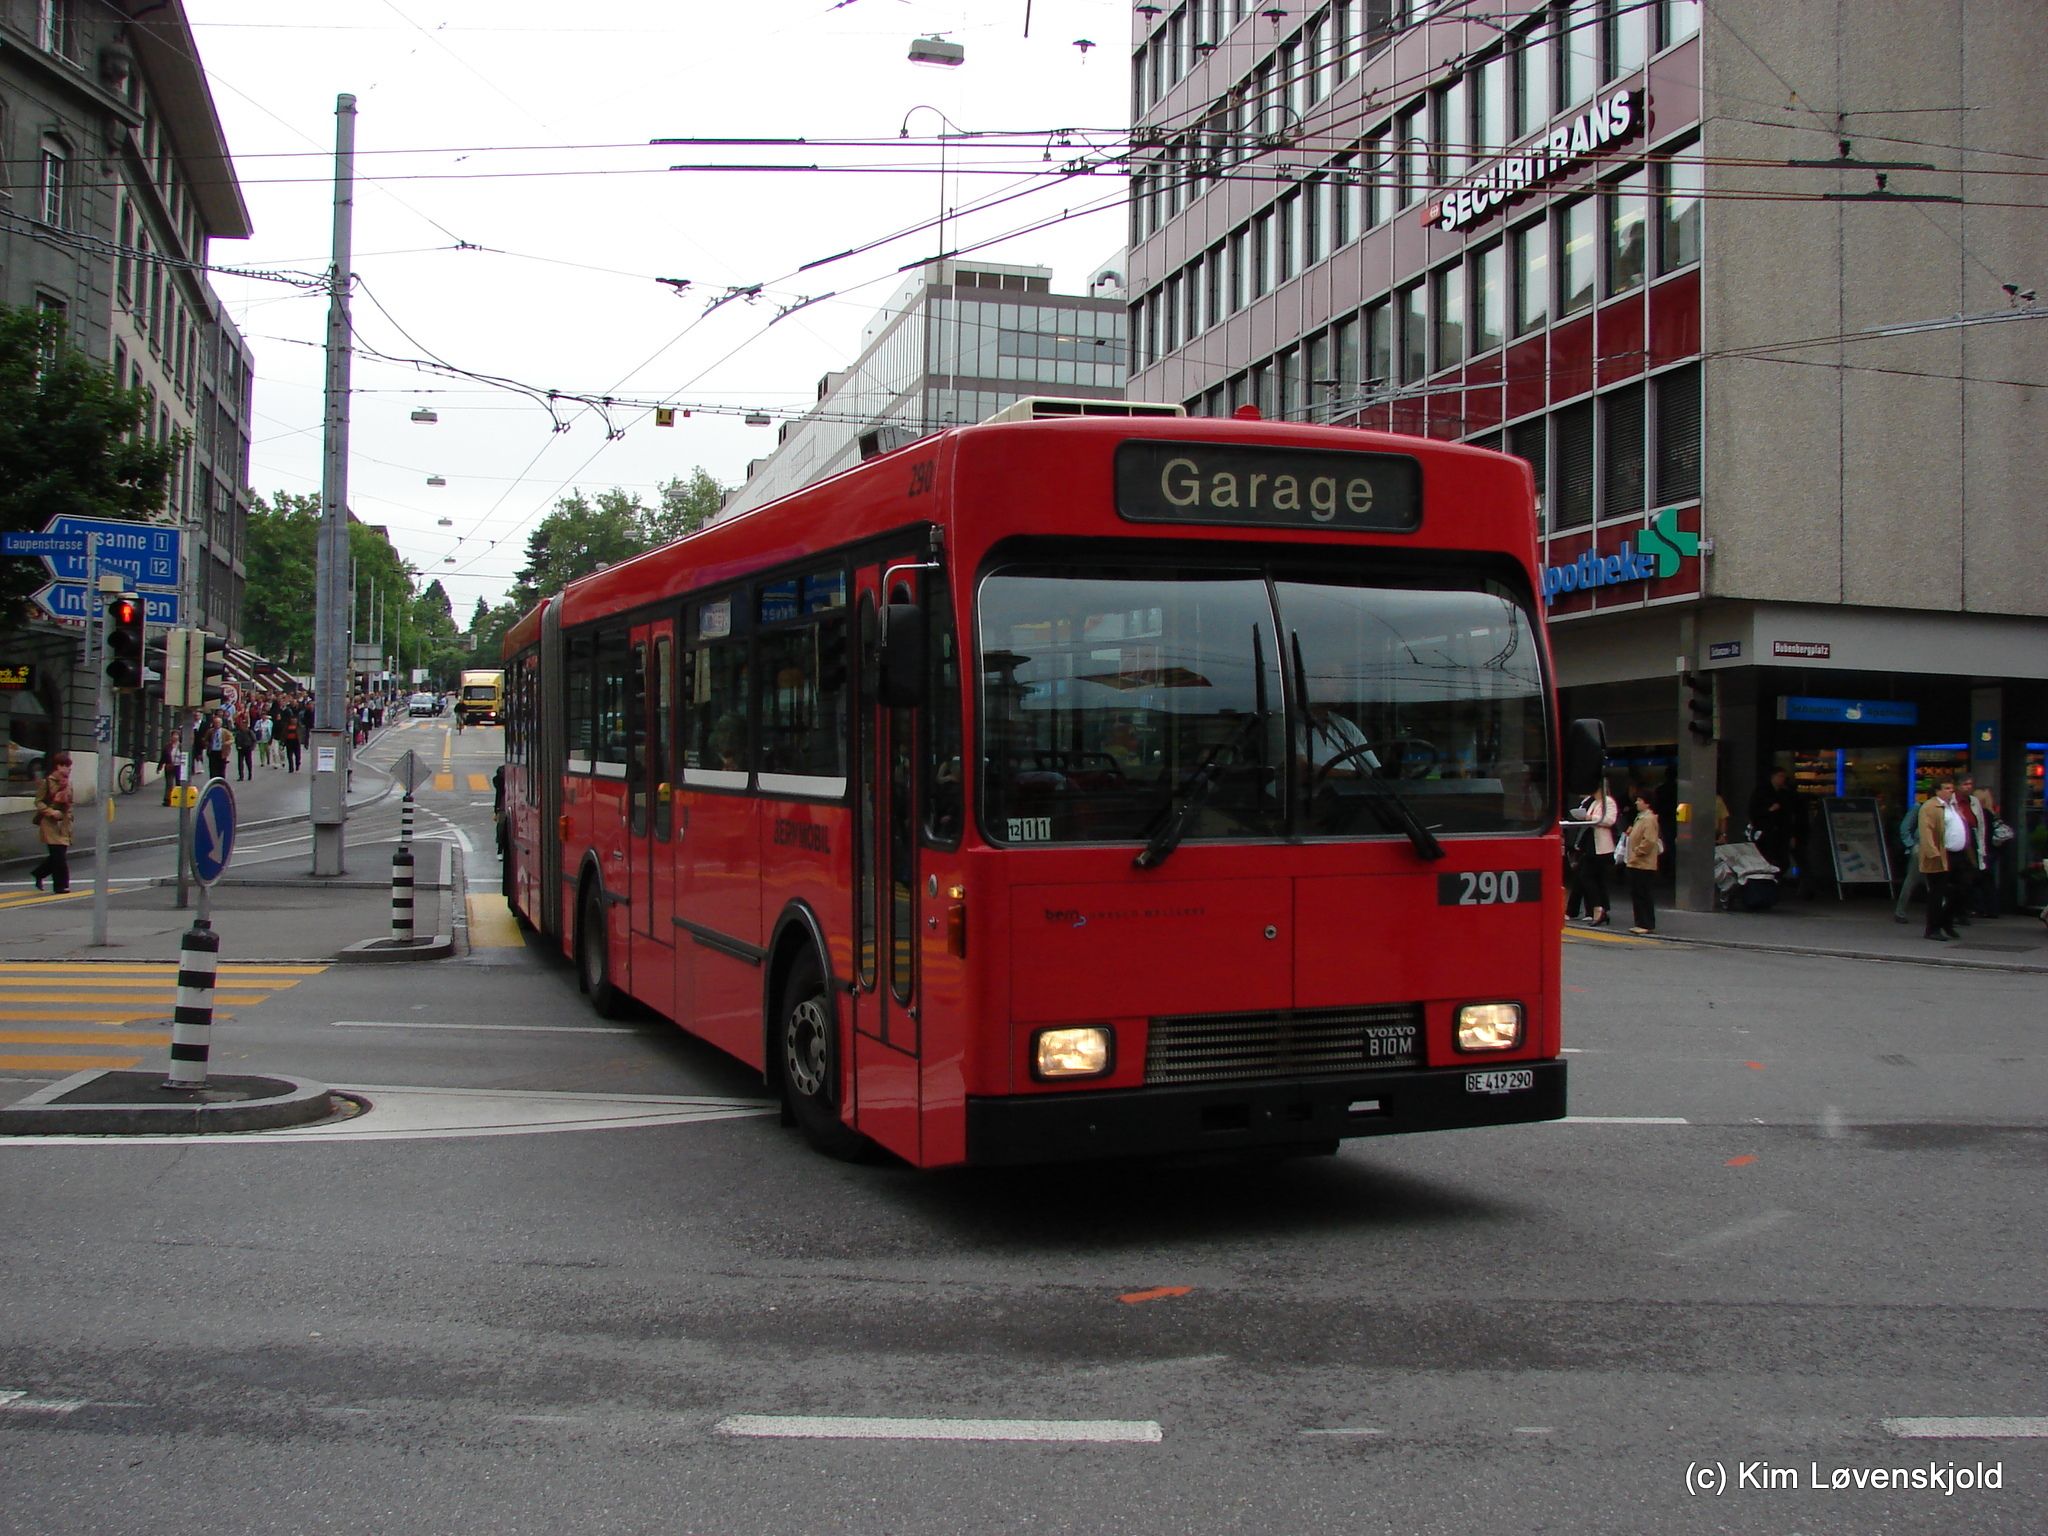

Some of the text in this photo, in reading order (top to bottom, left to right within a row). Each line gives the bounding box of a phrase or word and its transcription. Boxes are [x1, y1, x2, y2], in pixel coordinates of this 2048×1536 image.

[1441, 90, 1631, 232] SECURITRANS
[1161, 458, 1373, 522] Garage
[7, 537, 83, 552] Laupenstrasse
[65, 523, 147, 550] Lsanne
[60, 588, 171, 618] Inteen
[1774, 642, 1829, 656] Bubenbergplatz
[1459, 870, 1519, 905] 290
[1366, 1026, 1417, 1038] VOLVO
